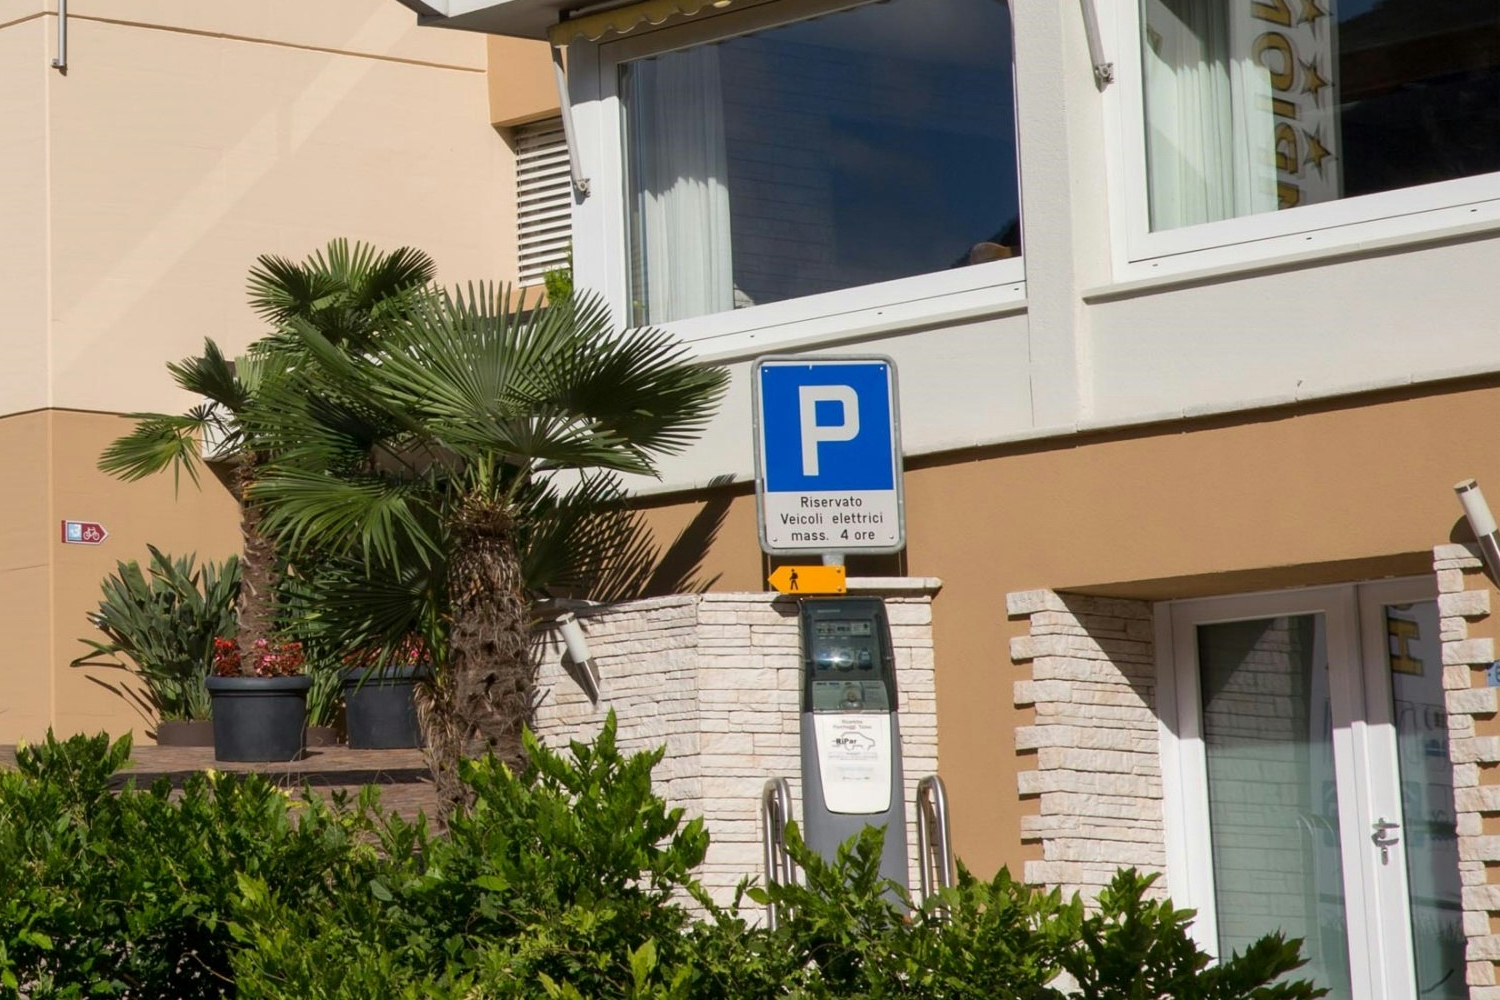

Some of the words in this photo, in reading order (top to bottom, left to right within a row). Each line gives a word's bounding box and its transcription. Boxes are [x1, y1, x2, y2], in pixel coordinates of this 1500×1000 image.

[799, 384, 860, 477] P
[800, 495, 863, 508] Riservato
[780, 512, 823, 525] Veicoli
[832, 511, 884, 524] elettrici
[791, 531, 830, 541] mass.
[840, 529, 849, 540] 4
[854, 531, 876, 540] ore
